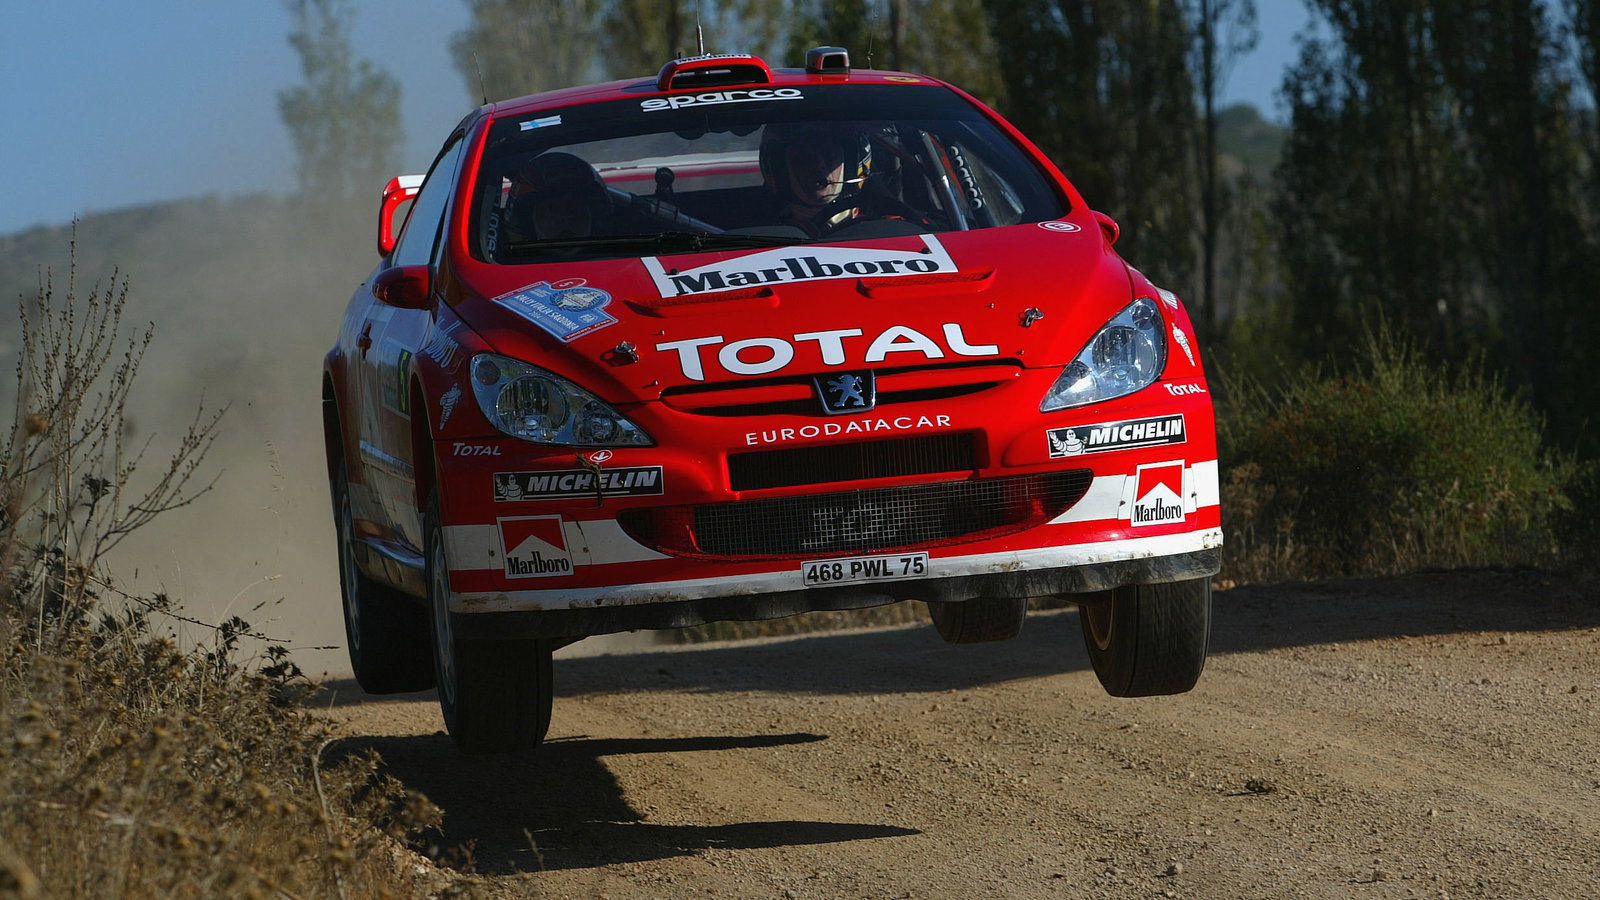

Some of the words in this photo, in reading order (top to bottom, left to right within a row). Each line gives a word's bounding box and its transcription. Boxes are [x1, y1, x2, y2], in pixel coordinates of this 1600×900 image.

[640, 88, 804, 112] sparco
[668, 256, 940, 296] Marlboro
[656, 322, 1000, 381] TOTAL
[1163, 383, 1207, 396] TOTAL
[745, 415, 951, 446] EURODATACAR
[1089, 418, 1182, 446] MICHELIN
[452, 442, 502, 457] TOTAL
[527, 470, 658, 492] MICHELIN
[1133, 498, 1182, 523] Marlboro
[507, 551, 570, 576] Marlboro
[807, 562, 844, 582] 468
[850, 559, 894, 579] PWL
[900, 556, 924, 576] 75
